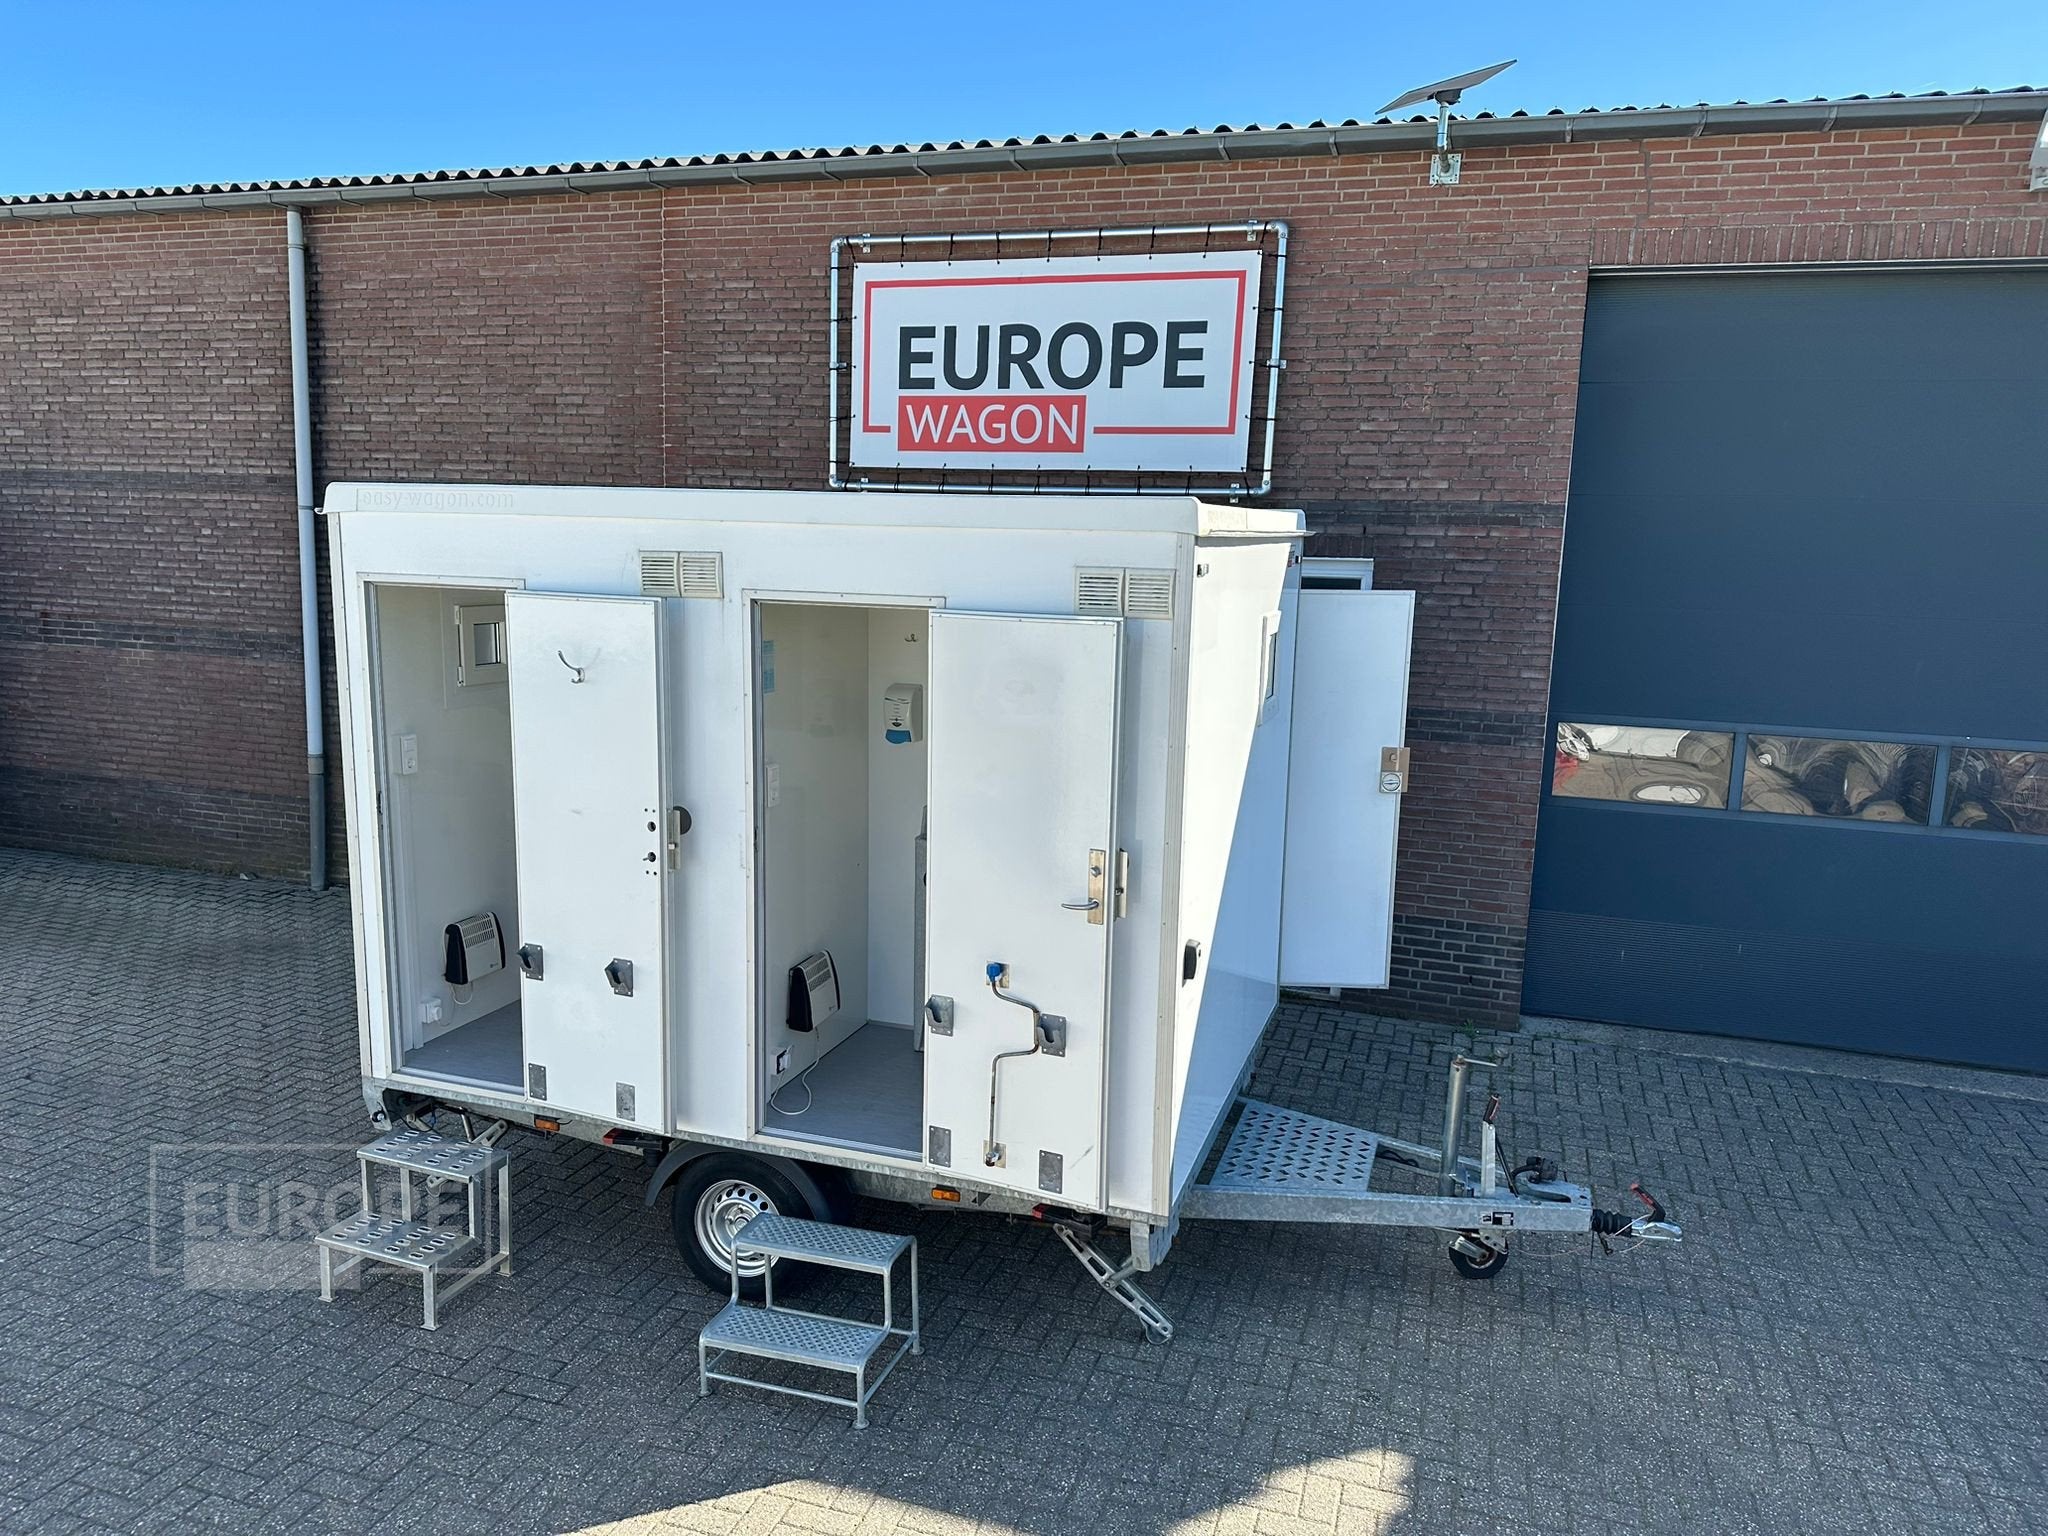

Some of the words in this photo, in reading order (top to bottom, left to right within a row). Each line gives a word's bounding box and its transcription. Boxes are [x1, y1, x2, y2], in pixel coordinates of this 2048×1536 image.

[899, 320, 1208, 390] EUROPE
[905, 404, 1079, 445] WAGON
[362, 490, 514, 510] easy-wagon.com
